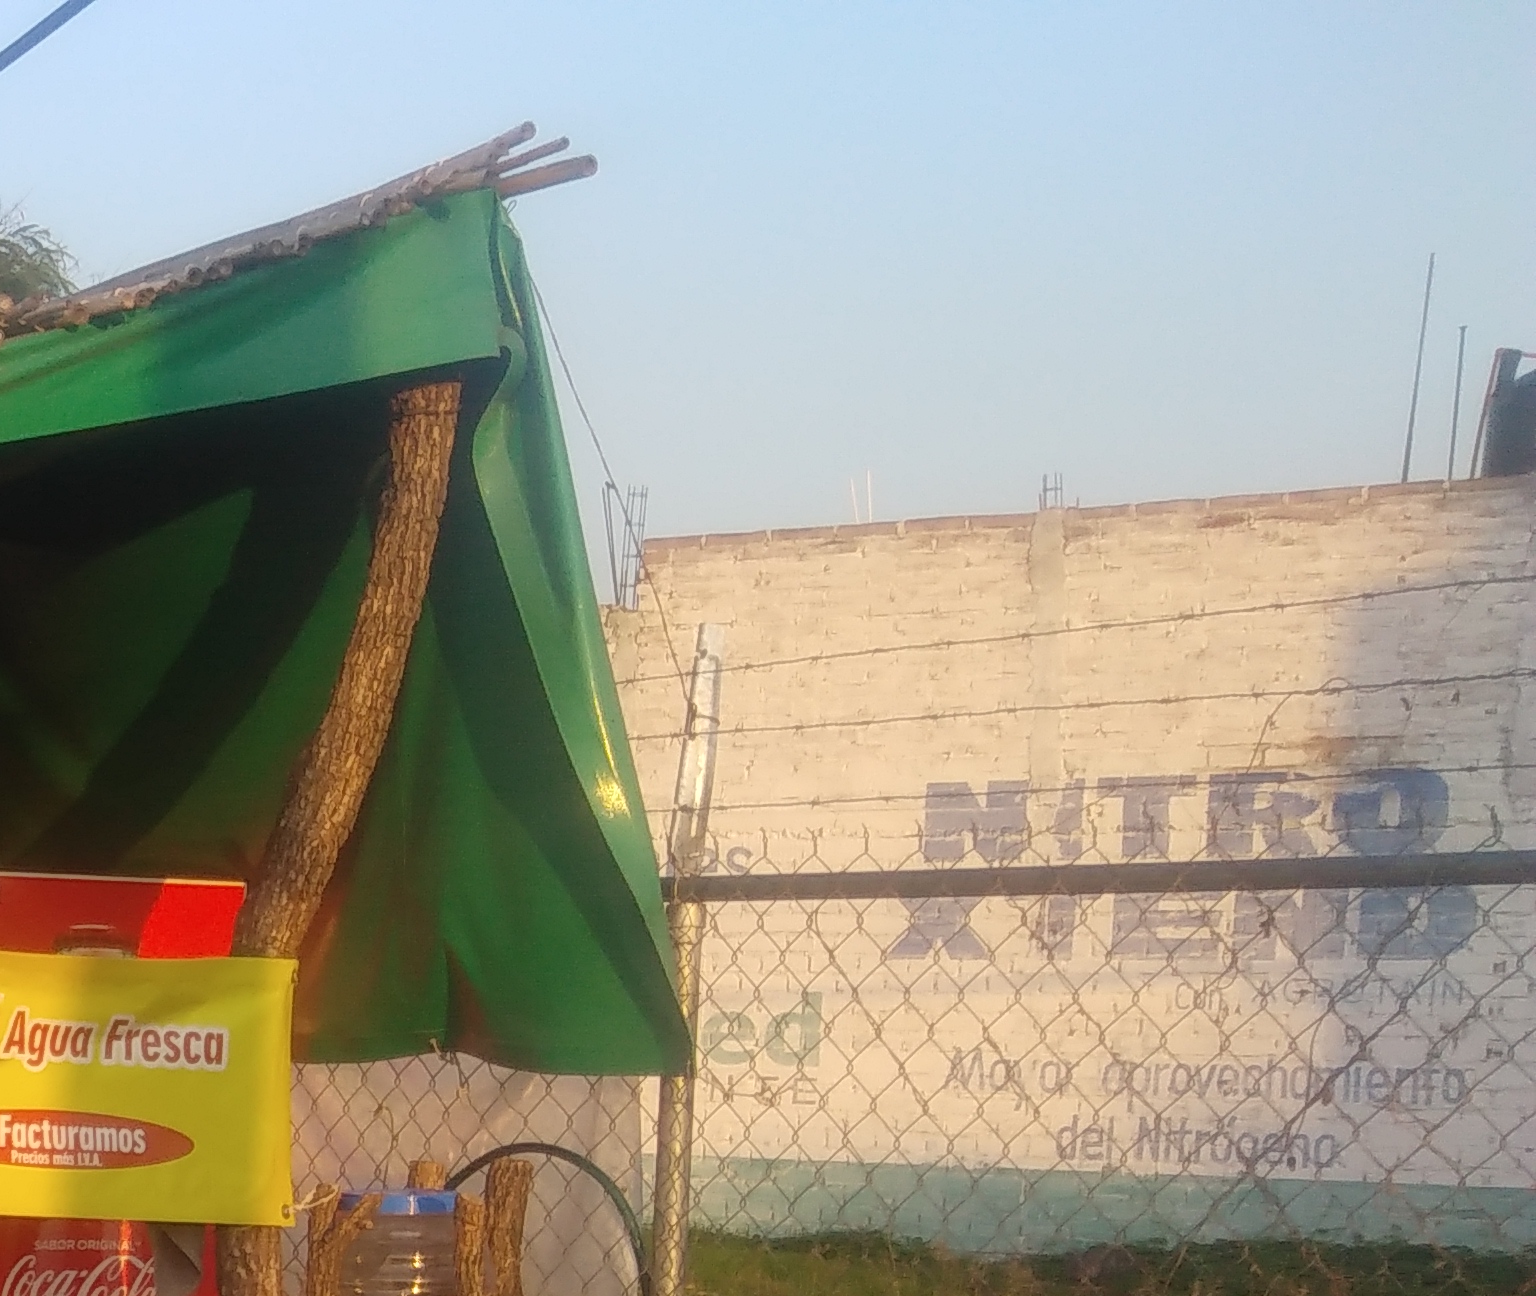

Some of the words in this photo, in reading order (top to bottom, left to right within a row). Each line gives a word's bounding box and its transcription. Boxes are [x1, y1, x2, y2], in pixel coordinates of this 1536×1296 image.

[3, 1011, 92, 1066] Agua
[104, 1018, 225, 1066] Fresca
[10, 1149, 50, 1166] Precios
[34, 1239, 75, 1251] SABOR
